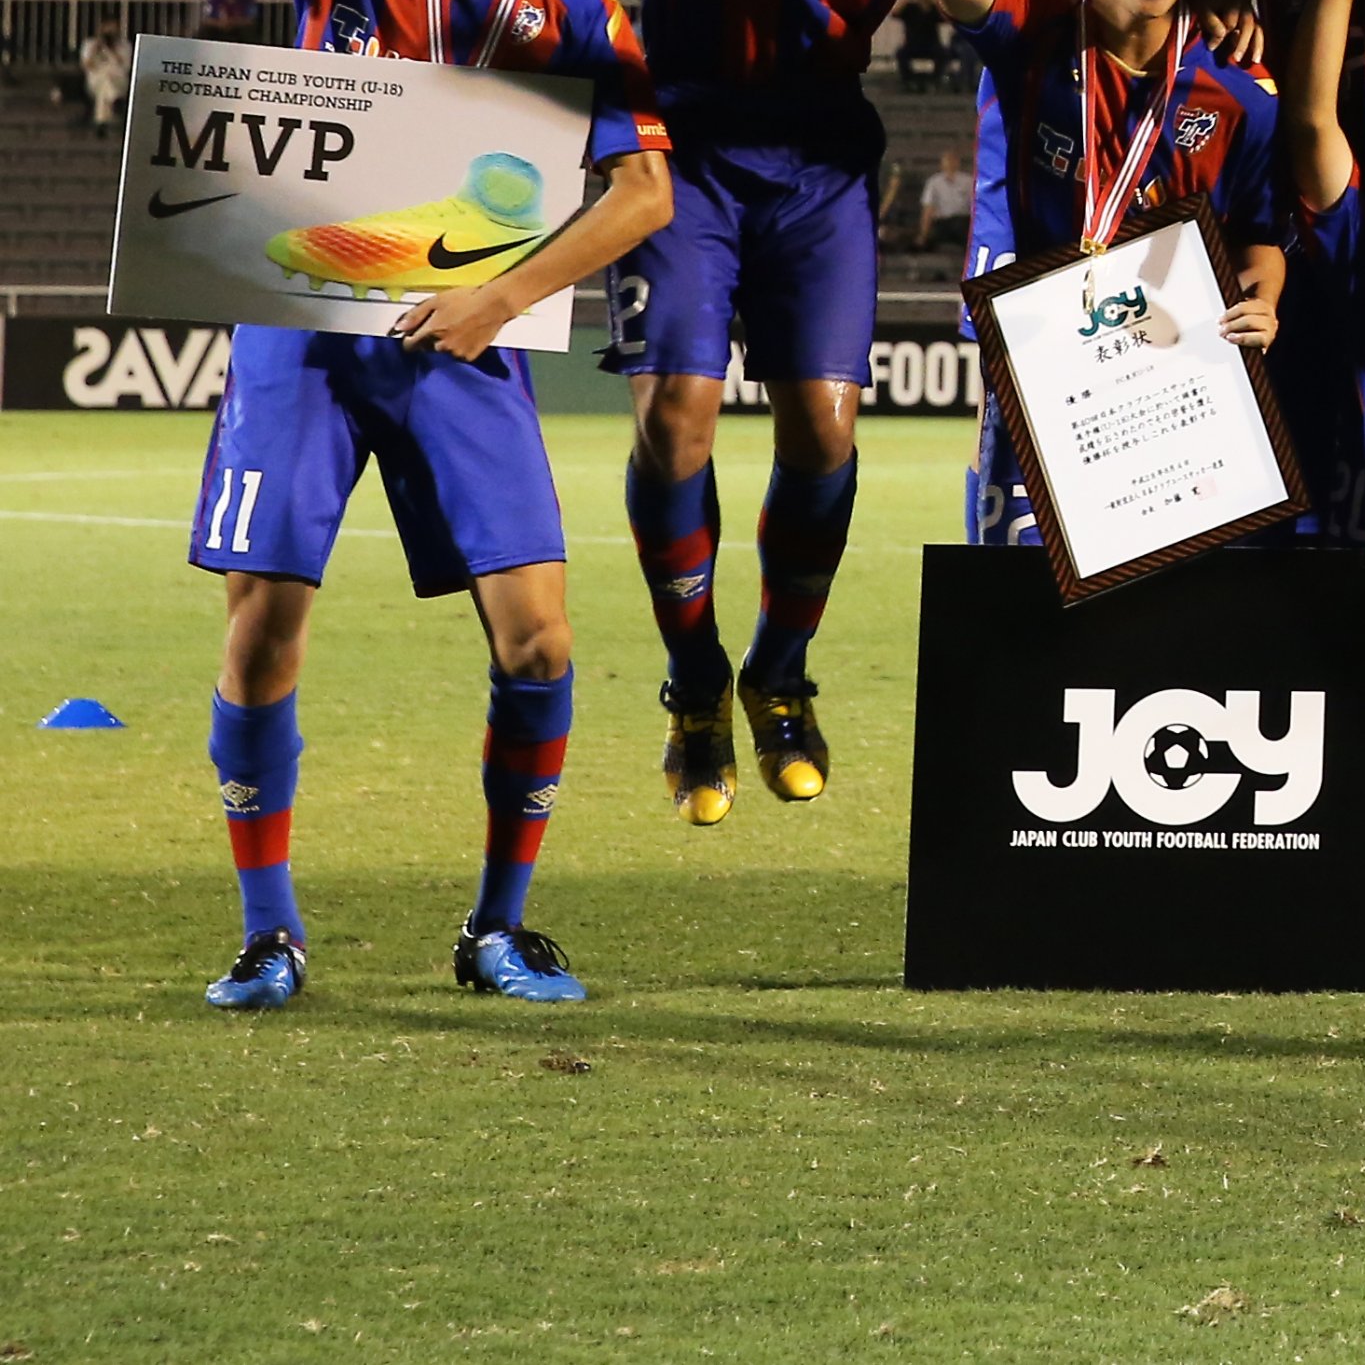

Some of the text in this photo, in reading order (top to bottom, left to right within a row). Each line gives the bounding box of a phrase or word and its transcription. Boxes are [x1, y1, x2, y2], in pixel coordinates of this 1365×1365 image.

[159, 80, 373, 112] FOOTBALL CHAMPIONSHIP
[162, 61, 403, 97] THE JAPAN CLUB YOUTH (U-18)
[151, 105, 355, 181] MVP
[1094, 329, 1153, 363] 表彰状
[205, 467, 263, 553] 11
[1009, 830, 1320, 850] JAPAN CLUB YOUTH FOOTBALL FEDERATION
